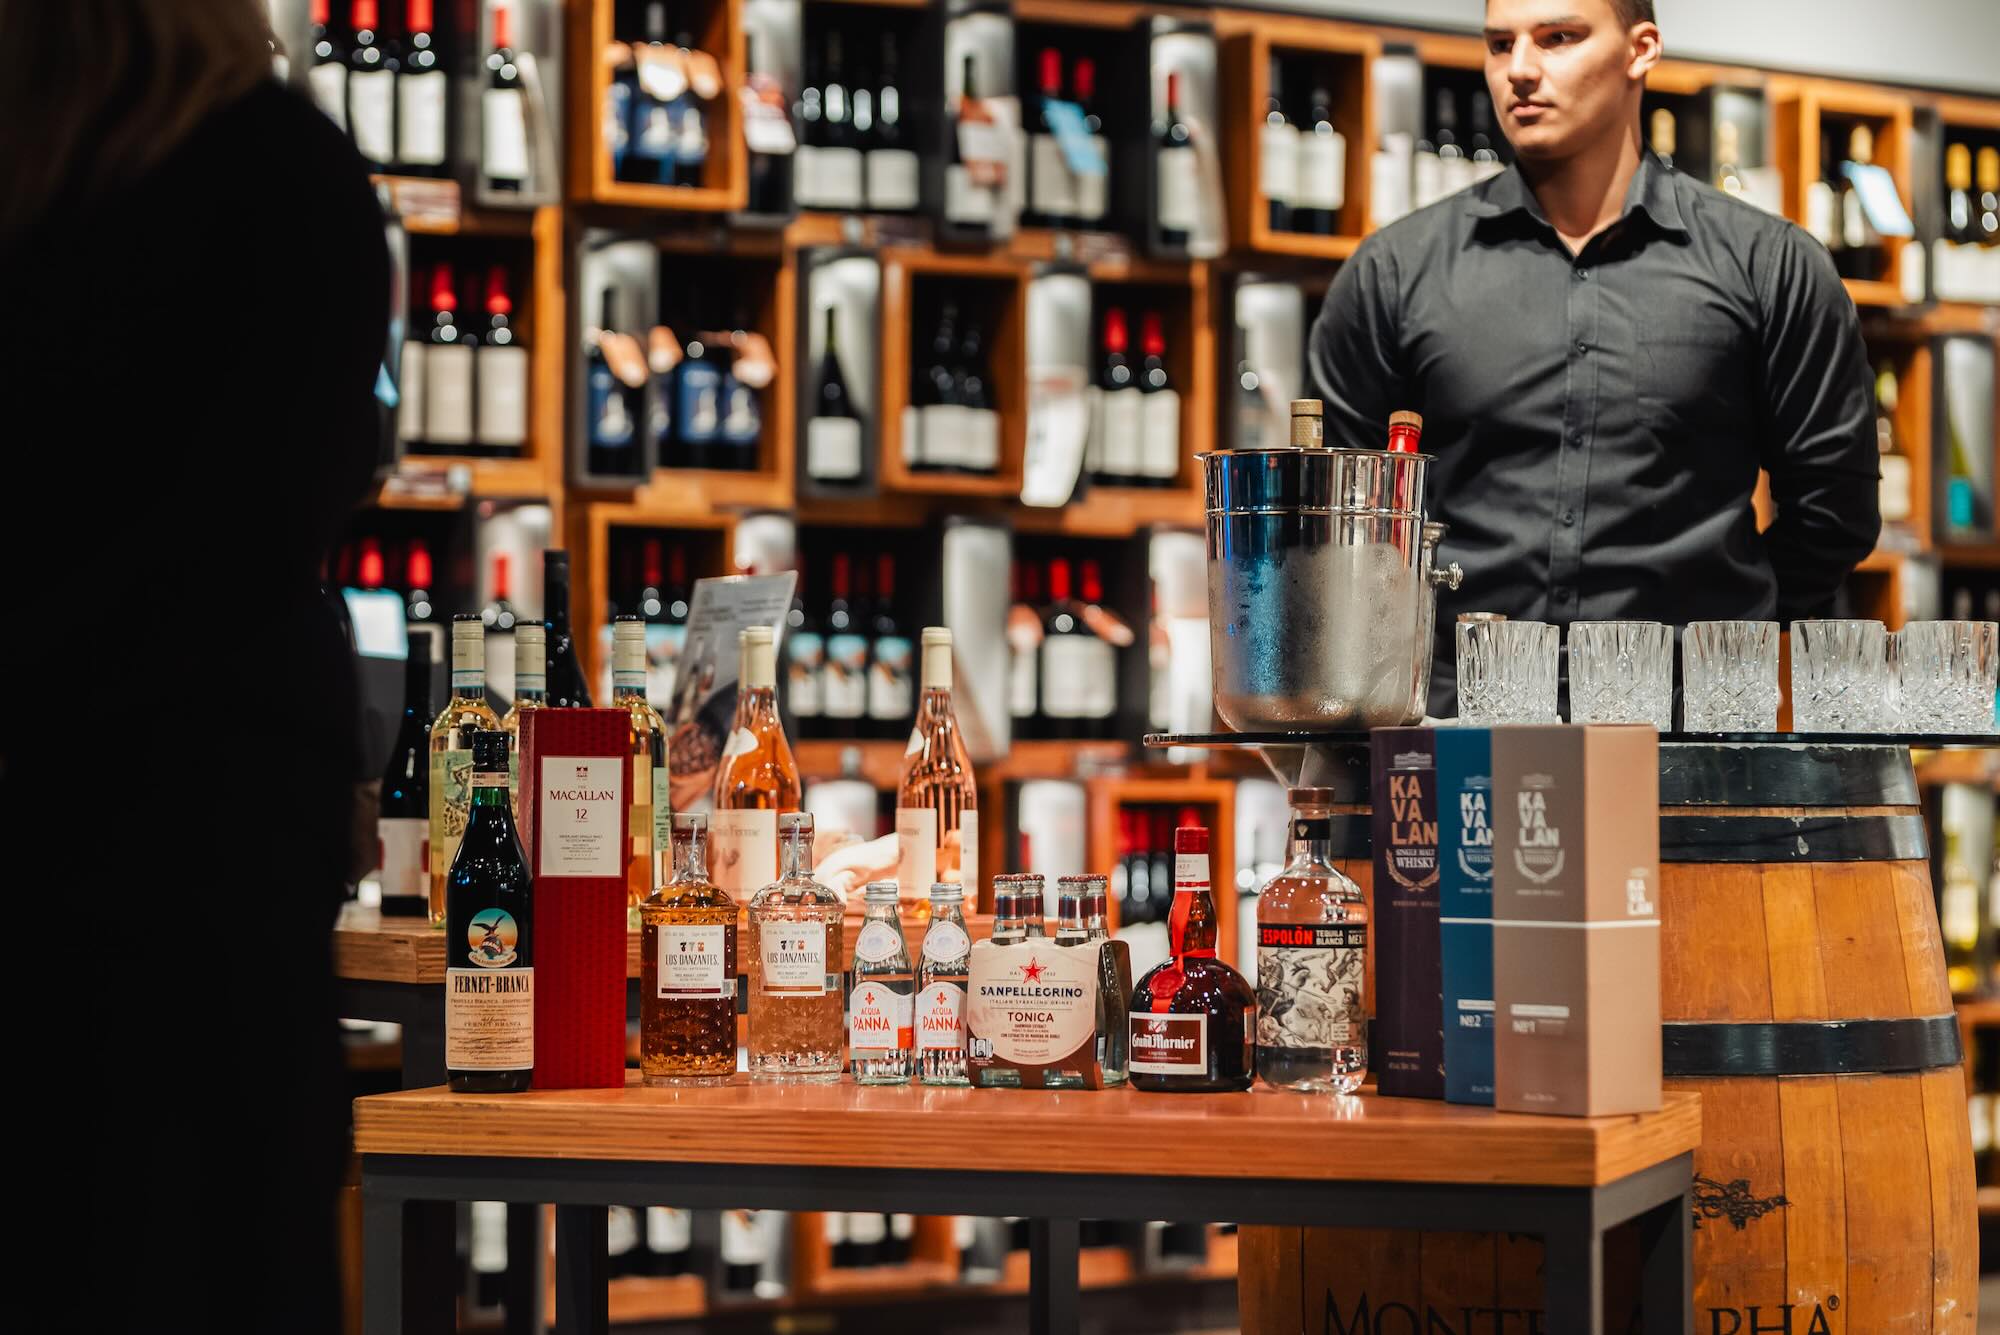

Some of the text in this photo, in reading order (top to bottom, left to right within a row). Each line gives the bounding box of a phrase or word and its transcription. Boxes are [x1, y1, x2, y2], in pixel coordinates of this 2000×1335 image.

[549, 790, 614, 801] MACALLAN
[1390, 775, 1422, 799] KA
[1460, 793, 1487, 810] KA
[1518, 791, 1546, 809] KA
[575, 808, 588, 819] 12
[1391, 799, 1423, 822] VA
[1392, 822, 1438, 845] LAN
[1520, 827, 1560, 846] LAN
[1396, 857, 1435, 868] WHISKY
[454, 975, 530, 994] FERNET-BRANCA
[980, 986, 1083, 998] SANPELLEGRINO
[853, 1016, 890, 1031] PANNA
[923, 1016, 961, 1031] PANNA
[1008, 1012, 1054, 1022] TONICA
[1152, 1033, 1196, 1050] Marnier
